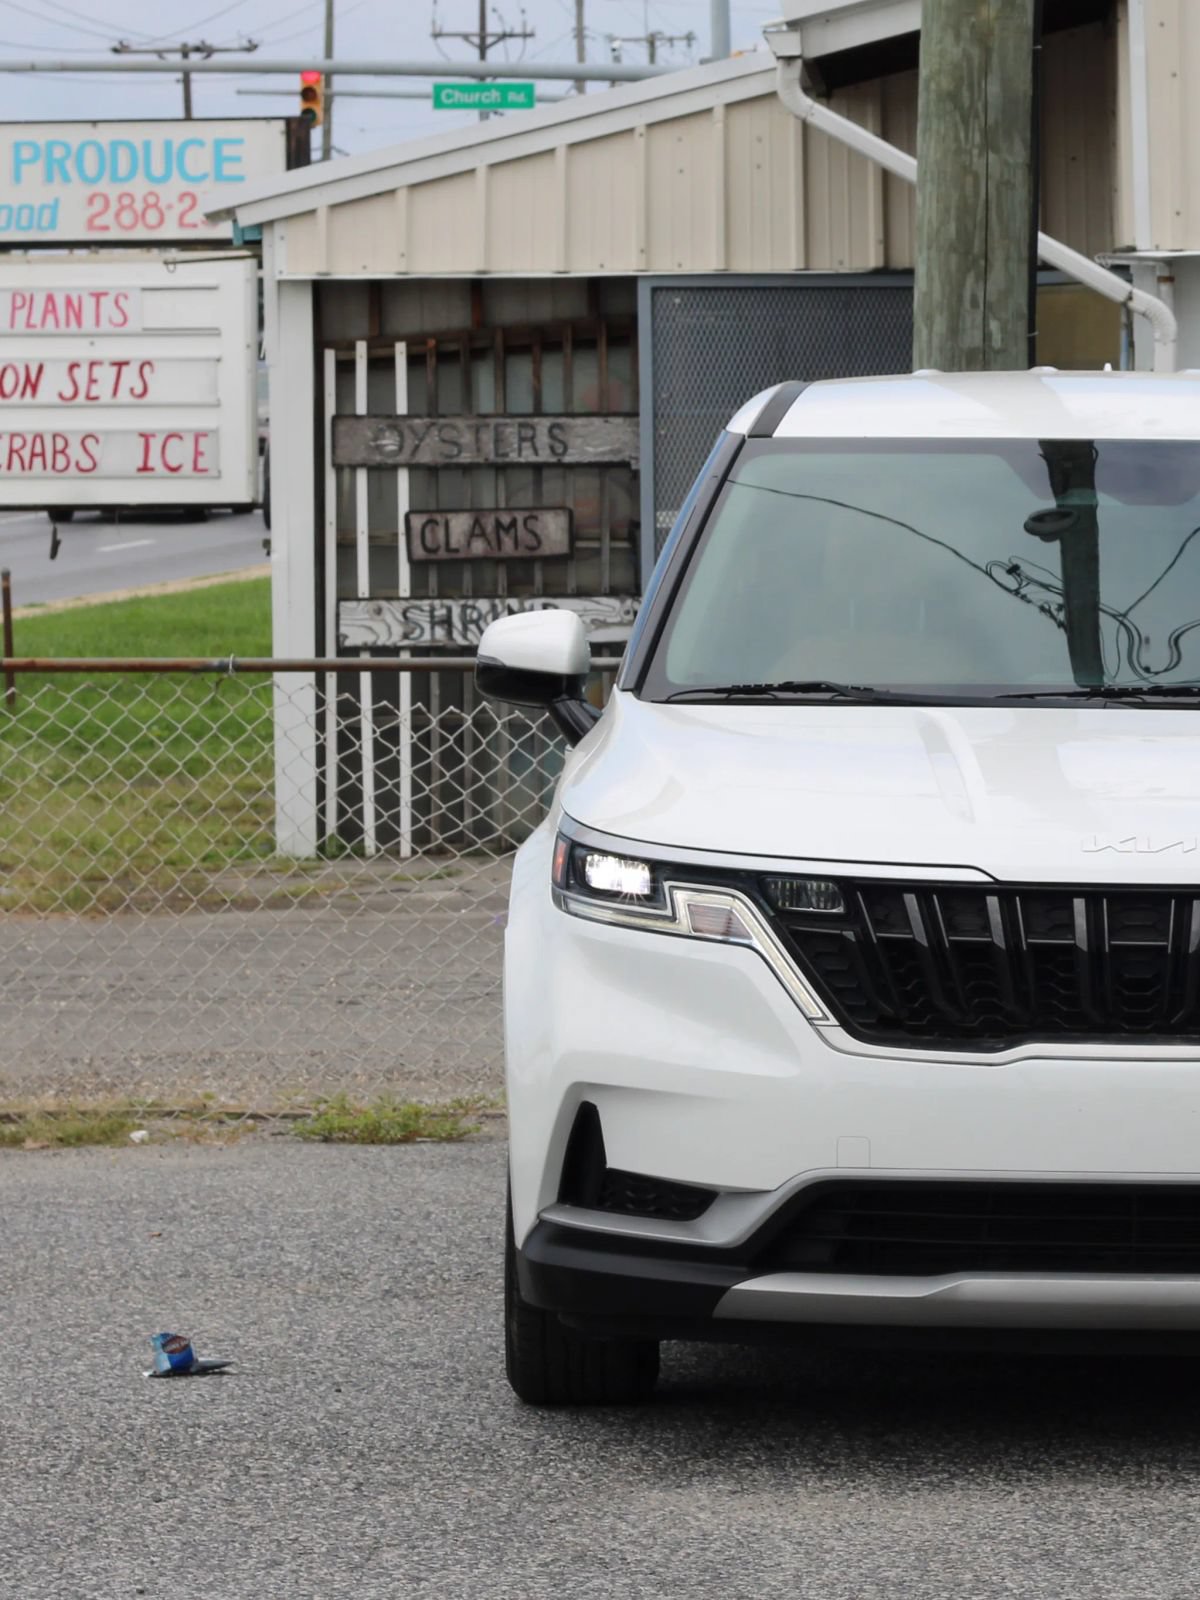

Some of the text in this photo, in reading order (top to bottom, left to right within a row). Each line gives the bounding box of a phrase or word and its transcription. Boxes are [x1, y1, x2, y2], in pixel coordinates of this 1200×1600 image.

[440, 88, 502, 104] Church
[12, 137, 246, 185] PRODUCE
[86, 190, 220, 232] 288-2
[10, 291, 129, 329] PLANTS
[58, 360, 155, 402] SETS
[0, 432, 210, 473] RABS ICE
[374, 422, 569, 459] OYSTERS
[420, 514, 543, 555] CLAMS
